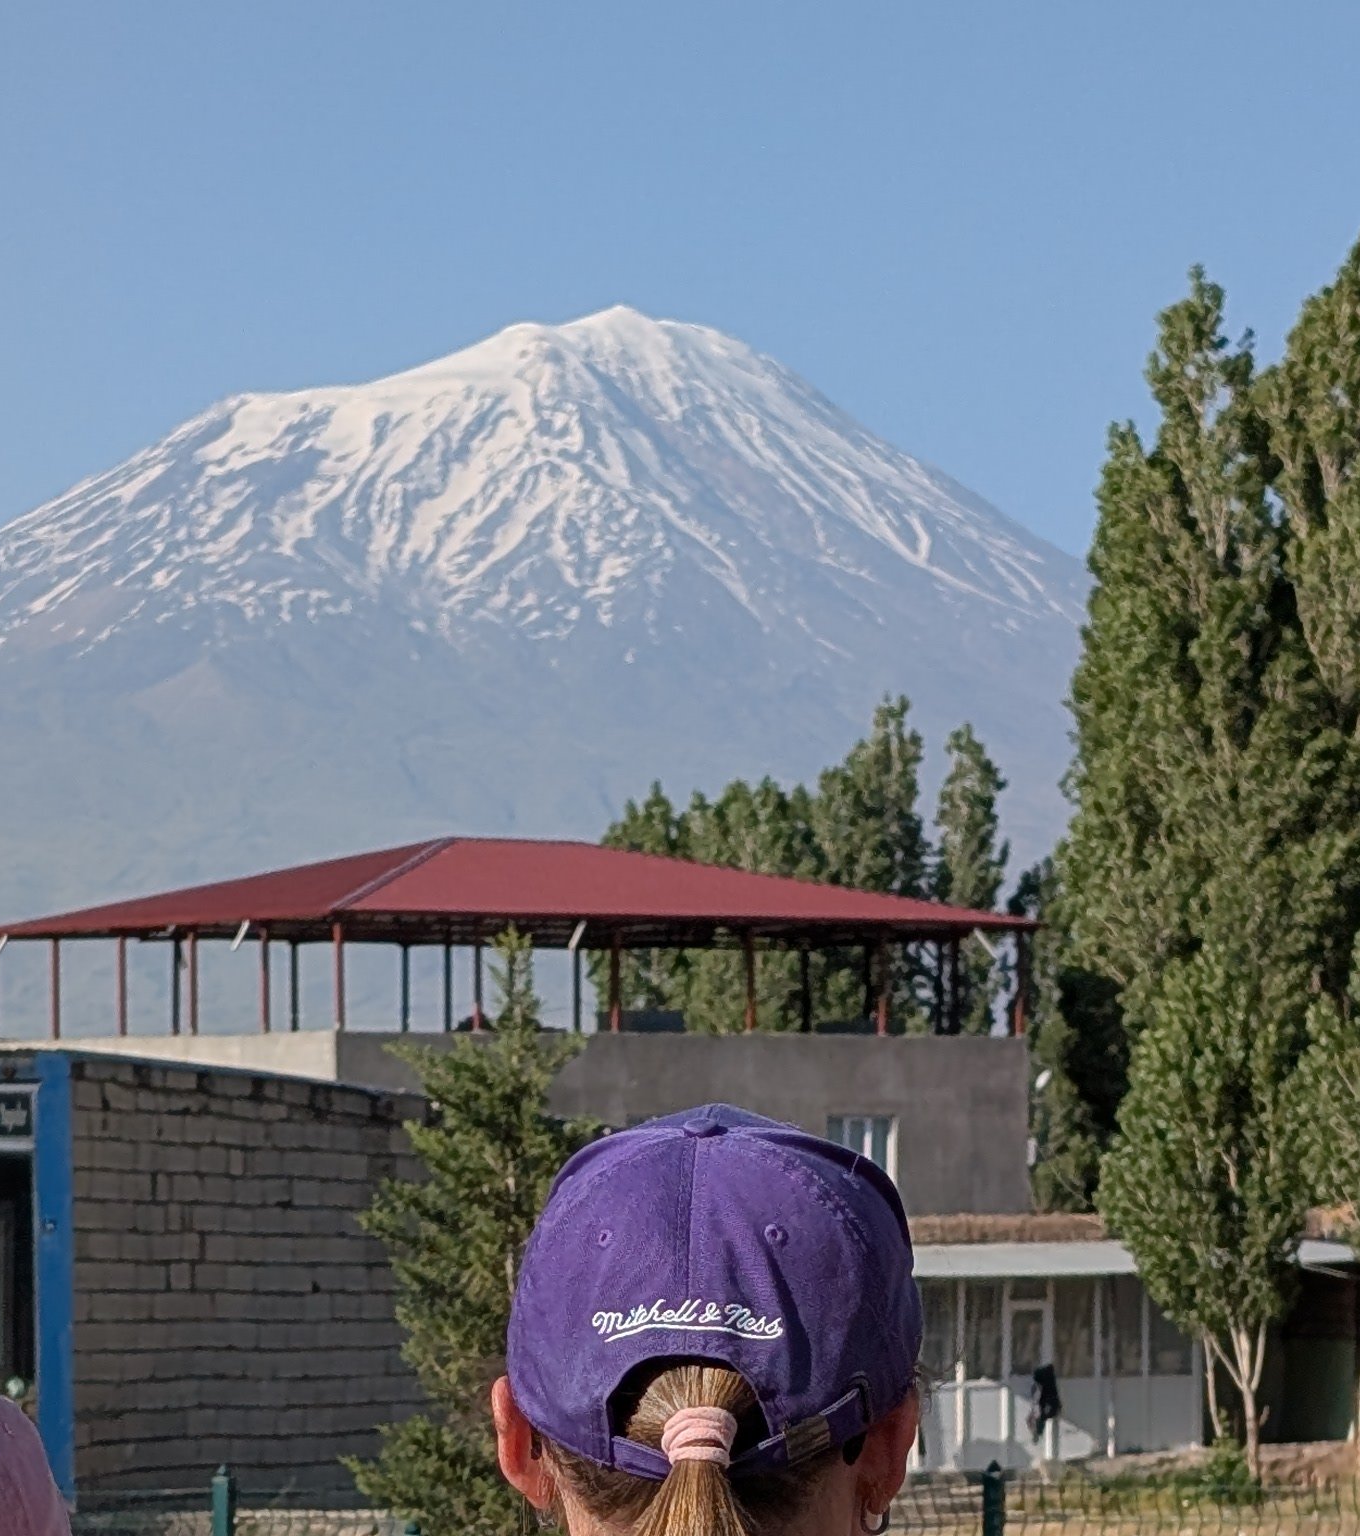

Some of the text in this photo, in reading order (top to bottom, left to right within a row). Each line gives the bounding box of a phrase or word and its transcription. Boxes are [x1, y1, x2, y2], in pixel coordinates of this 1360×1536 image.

[592, 1299, 783, 1336] Mitchell & Ness
